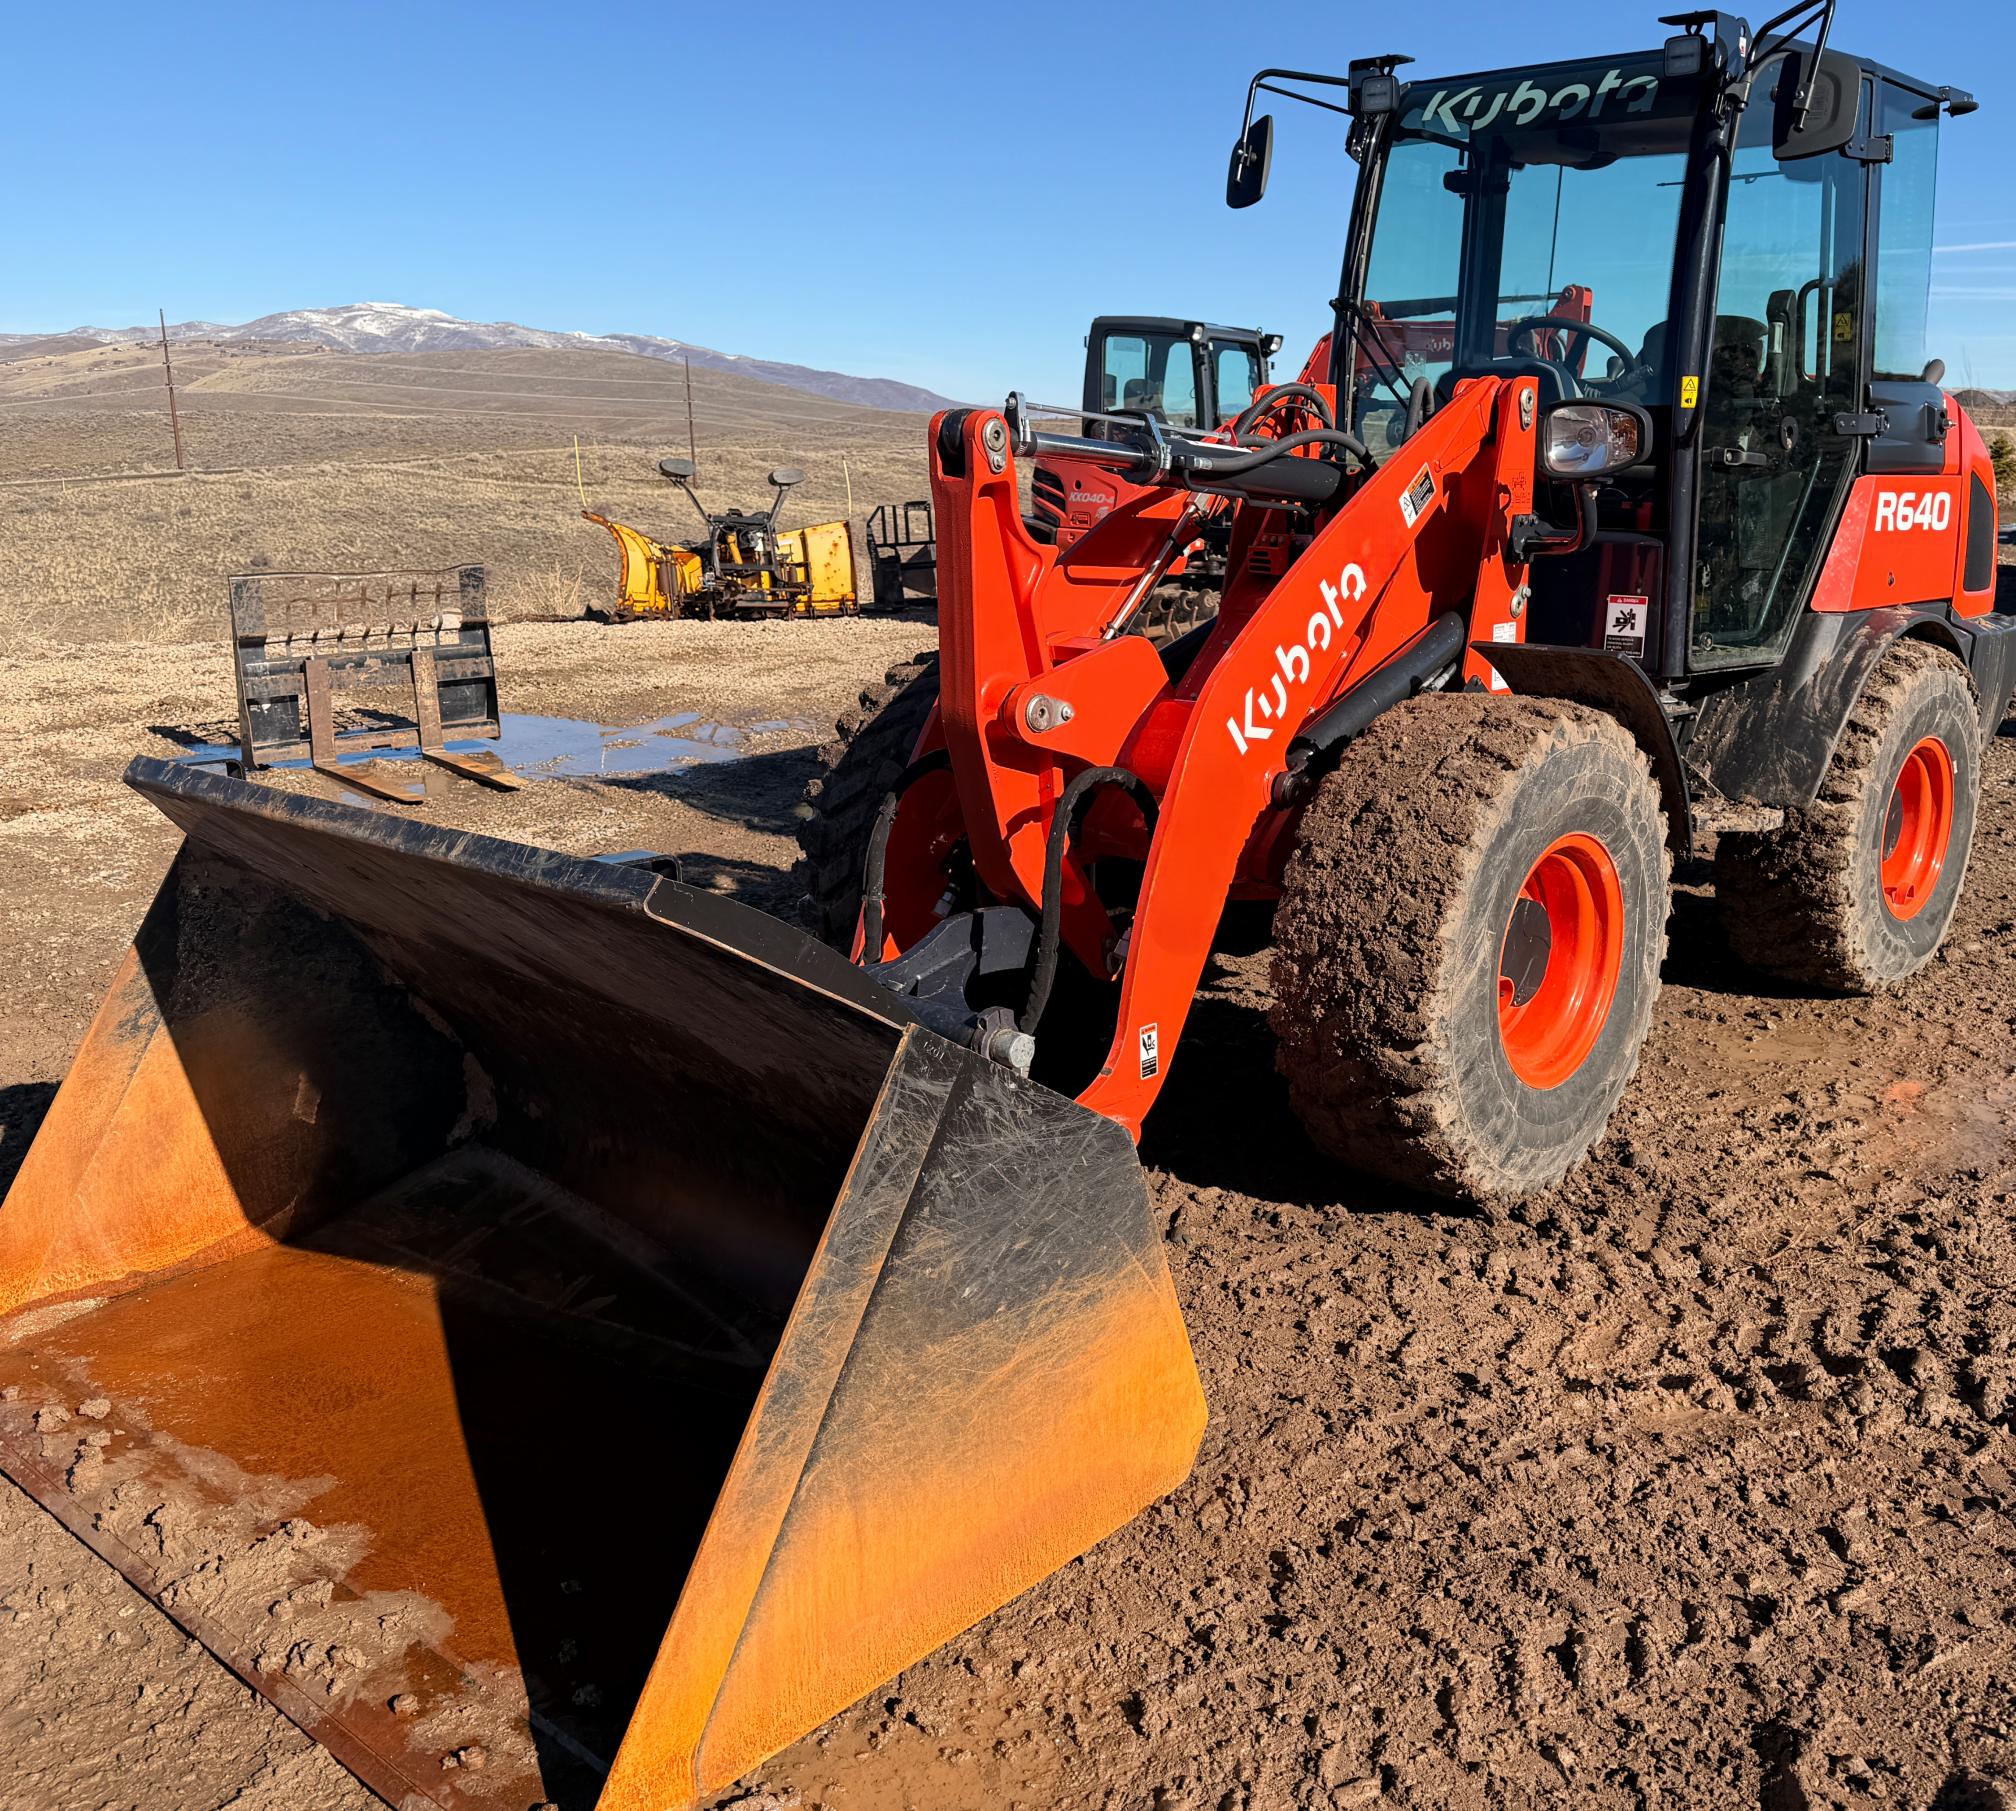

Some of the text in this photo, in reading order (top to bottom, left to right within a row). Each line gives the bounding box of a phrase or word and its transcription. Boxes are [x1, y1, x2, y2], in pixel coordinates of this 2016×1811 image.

[1421, 69, 1658, 133] Kubota
[1874, 491, 1951, 532] R640
[1226, 562, 1367, 756] Kubota
